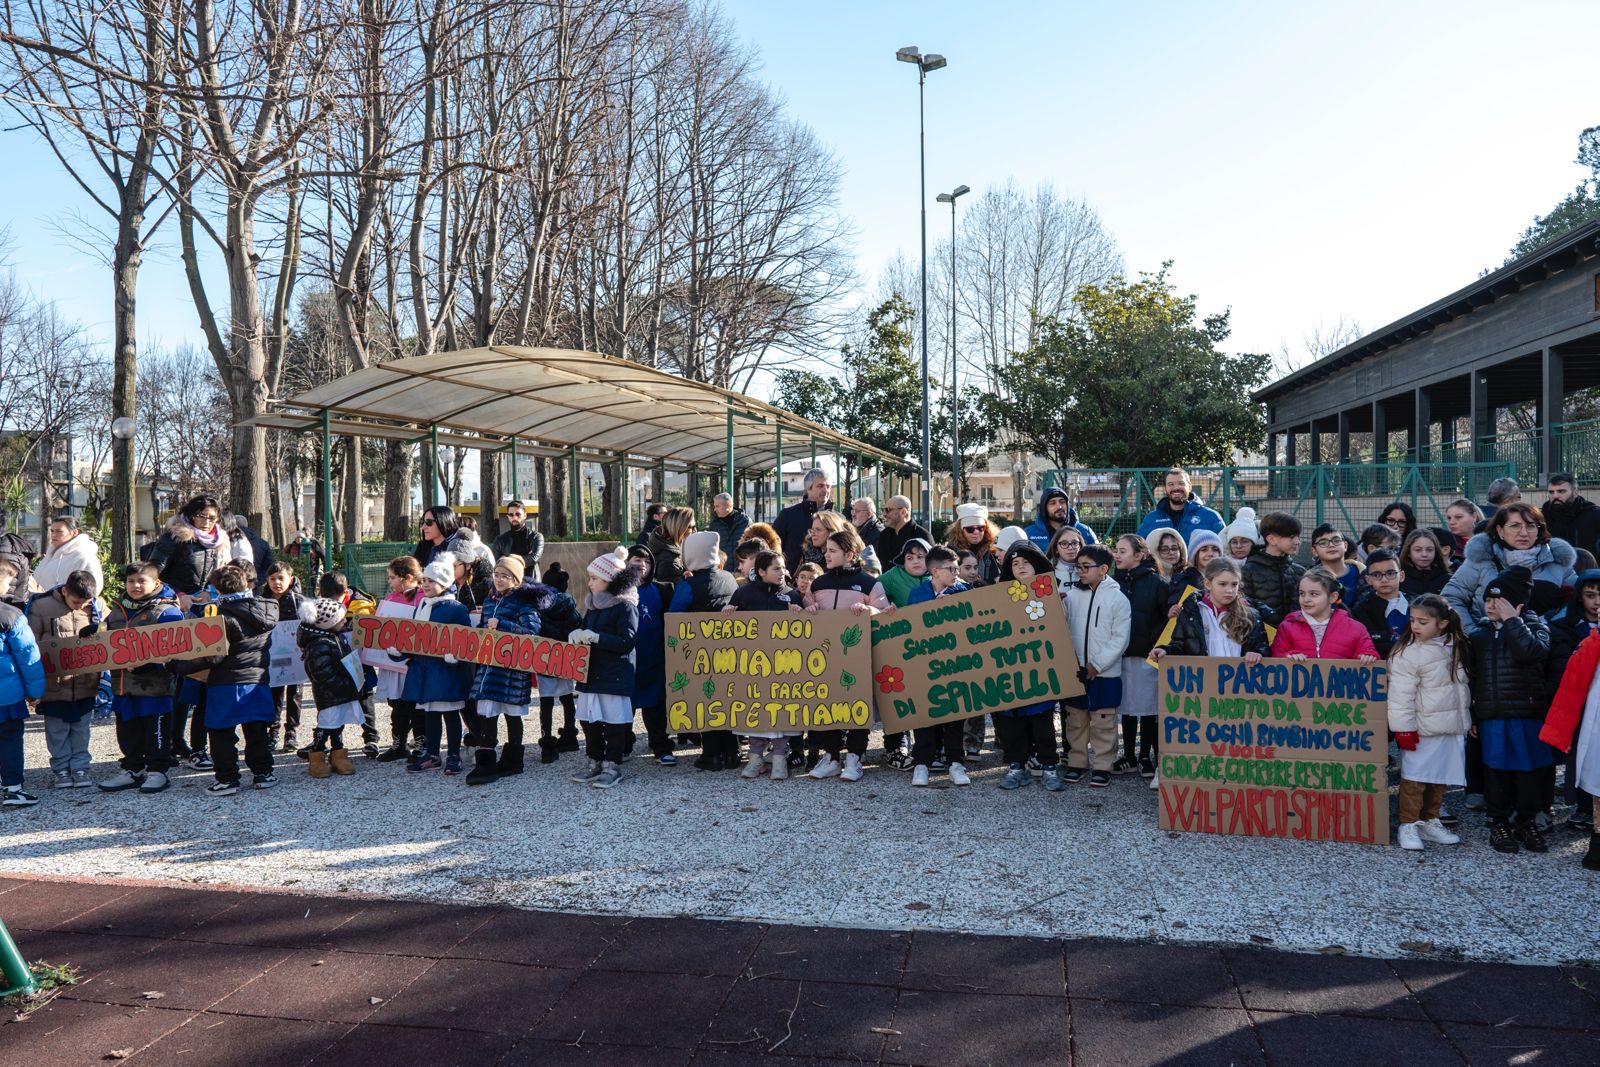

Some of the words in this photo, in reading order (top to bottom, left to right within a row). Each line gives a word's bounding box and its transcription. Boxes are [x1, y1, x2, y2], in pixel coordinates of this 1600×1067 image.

[678, 621, 696, 640] IL
[699, 617, 759, 640] VERDE
[770, 619, 813, 639] NOI
[60, 643, 108, 670] PLESSO
[110, 627, 193, 665] SPINELLI
[358, 618, 479, 661] TORNIAMO
[477, 632, 495, 665] A
[494, 635, 589, 682] GIOCARE
[902, 632, 957, 661] SIAMO
[927, 652, 983, 680] SIAMO
[990, 640, 1054, 668] TUTTI
[726, 682, 736, 698] E
[746, 684, 761, 699] IL
[769, 681, 829, 699] PARCO
[893, 698, 916, 718] DI
[927, 667, 1061, 718] SPINELLI
[1167, 665, 1204, 694] UN
[1218, 663, 1290, 696] PARCO
[1291, 664, 1325, 699] DA
[1326, 665, 1388, 701] AMARE
[669, 700, 870, 731] RISPETTIAMO
[1165, 692, 1200, 718] UN
[1273, 699, 1302, 722] DA
[1312, 701, 1368, 726] DARE
[1164, 715, 1201, 744] PER
[1205, 721, 1253, 746] OGNI
[1256, 723, 1330, 751] BAMBINO
[1332, 730, 1375, 752] CHE
[1211, 743, 1277, 760] VUOLE
[1294, 760, 1379, 794] RESPIRARE
